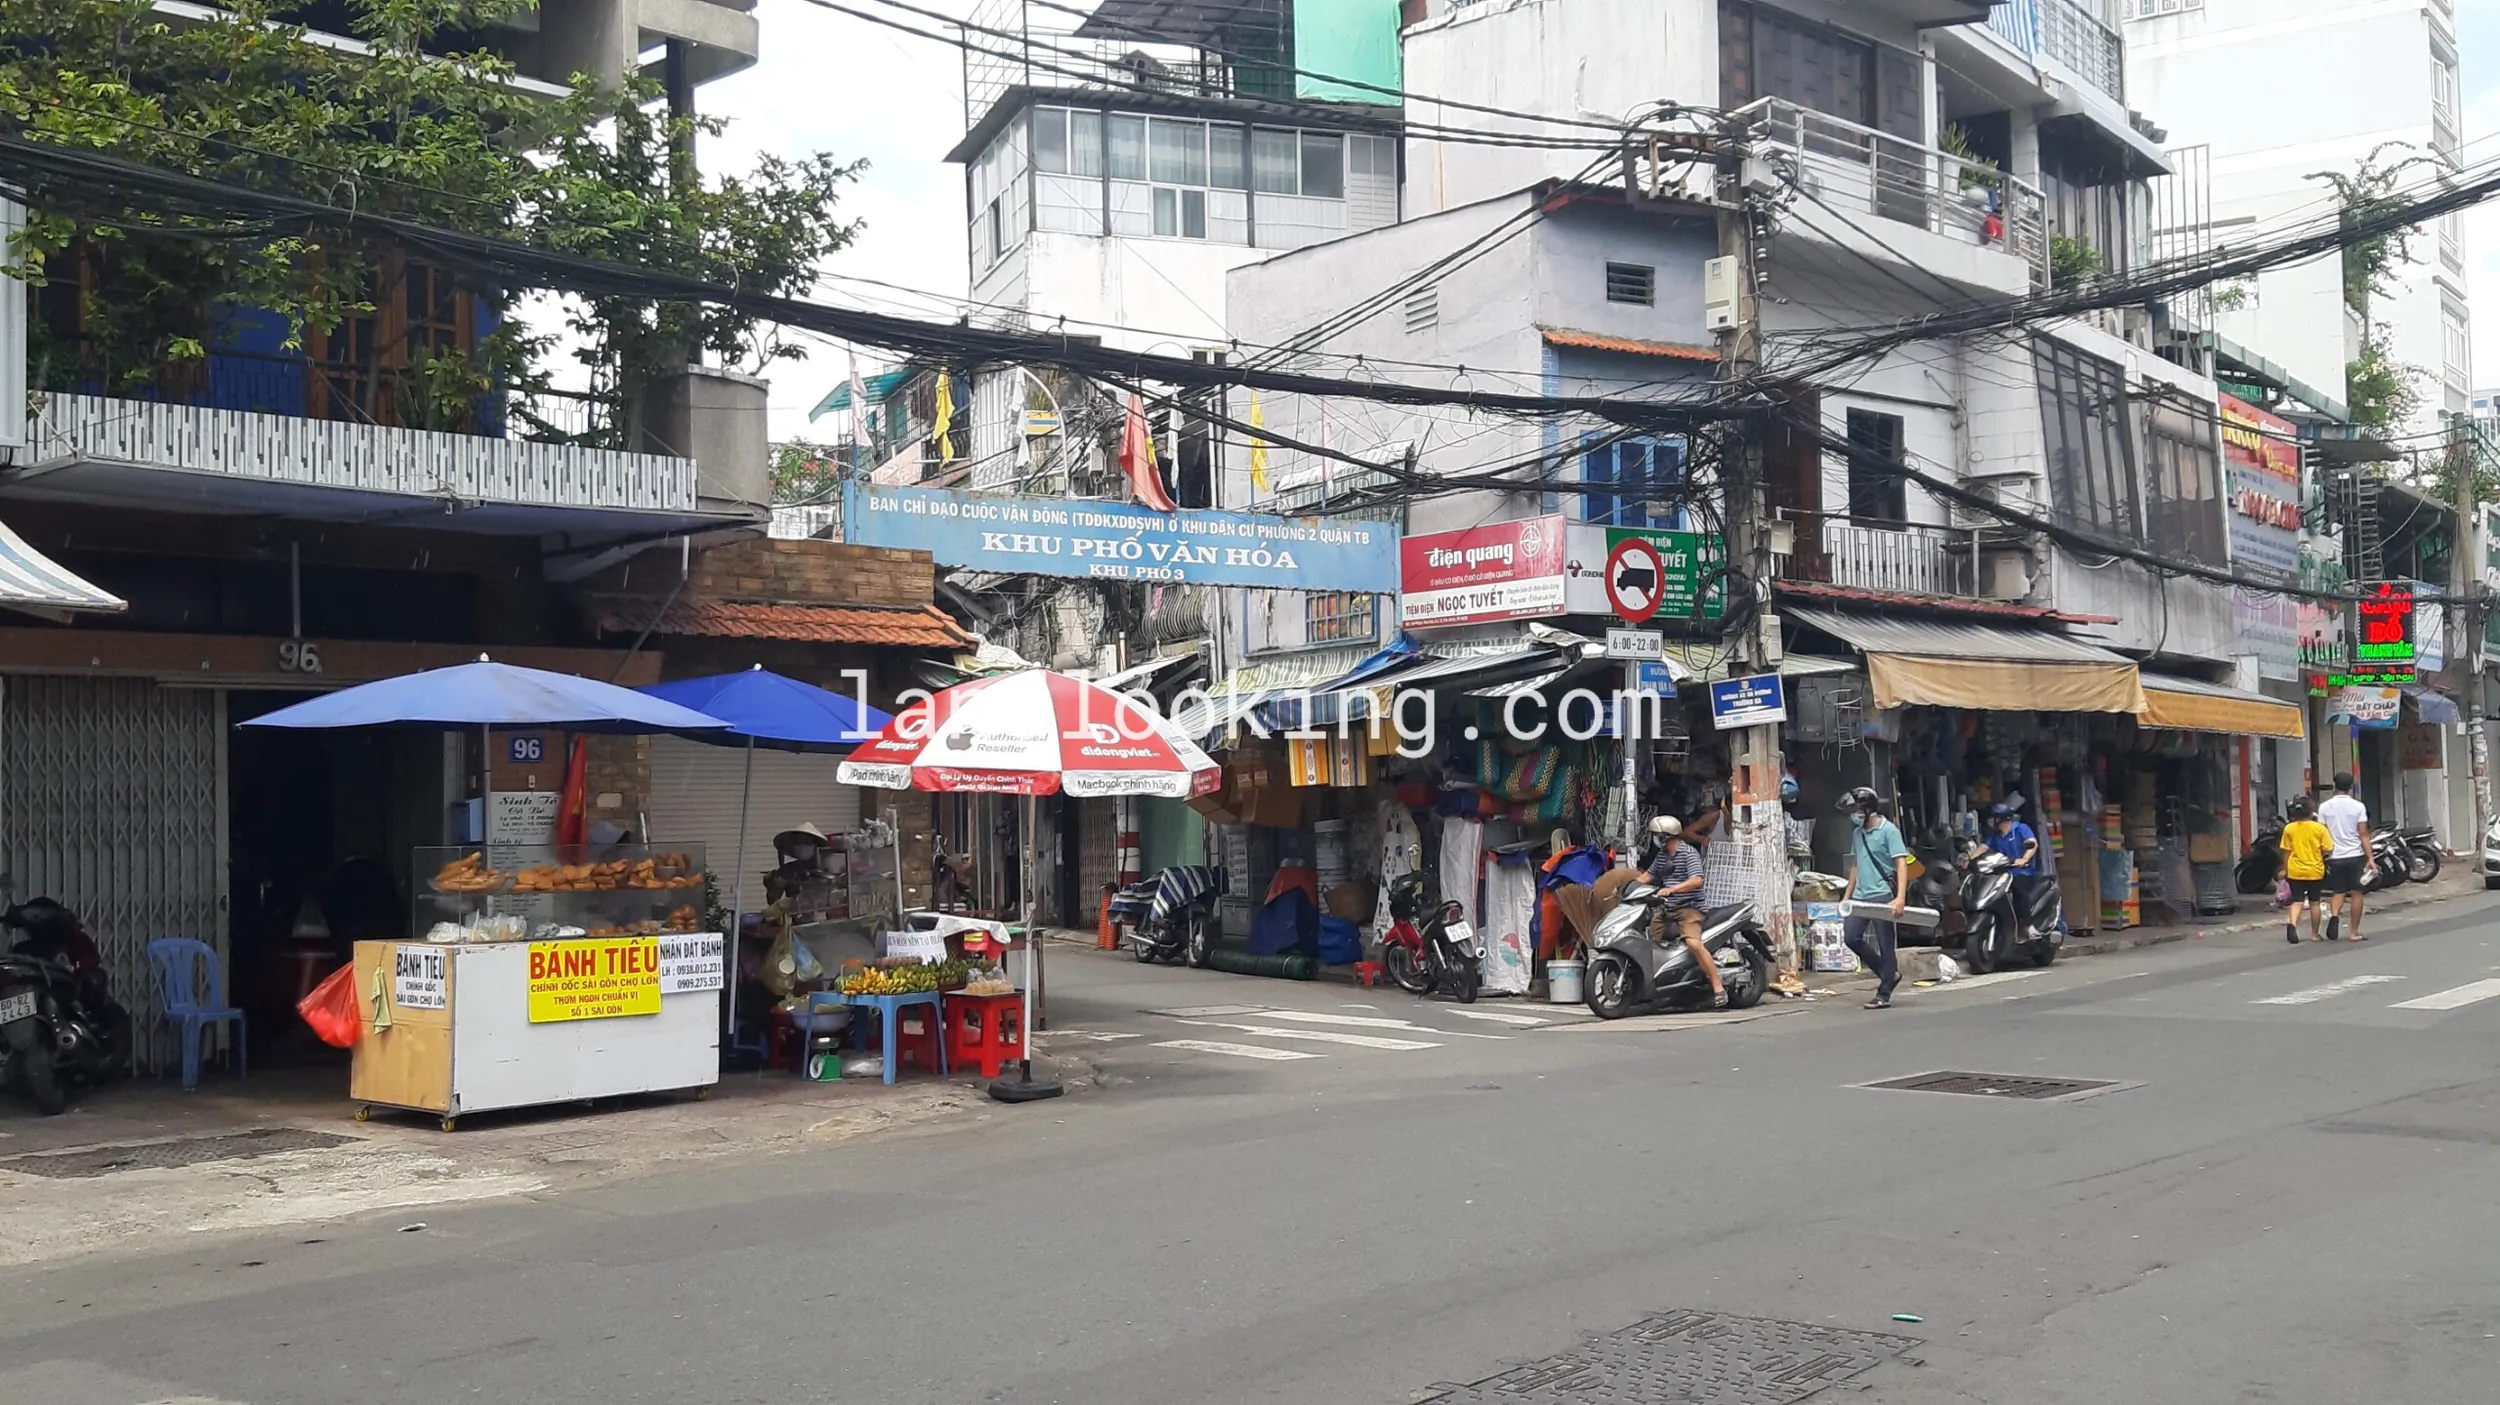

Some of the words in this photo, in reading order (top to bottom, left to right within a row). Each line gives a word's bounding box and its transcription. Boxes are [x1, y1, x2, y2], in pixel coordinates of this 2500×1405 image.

[870, 497, 899, 512] BAN
[903, 495, 926, 514] CHỈ
[931, 502, 958, 519] ĐẠO
[962, 502, 998, 520] CUỘC
[1002, 506, 1029, 523] VẬN
[1032, 506, 1068, 527] ĐỘNG
[1182, 520, 1206, 534] KHU
[1210, 520, 1235, 536] DÂN
[1239, 522, 1256, 537] CƯ
[1308, 530, 1317, 541] 2
[1320, 529, 1351, 546] QUẬN
[1354, 531, 1370, 545] TB
[980, 532, 1063, 555] KHU
[1071, 529, 1143, 560] PHỐ
[1147, 539, 1219, 565] VĂN
[1224, 542, 1298, 569] HÓA
[1424, 547, 1462, 568] điện
[1466, 543, 1514, 569] quang
[1089, 564, 1128, 577] KHU
[1136, 562, 1172, 579] PHỐ
[1174, 569, 1185, 580] 3
[1437, 594, 1467, 614] NGỌC
[1469, 585, 1504, 609] TUYẾT
[1612, 637, 1659, 652] 6:00-22:00
[278, 640, 319, 673] 96
[514, 738, 541, 759] 96
[977, 743, 1027, 754] Reseller
[1078, 778, 1122, 789] Macbook
[499, 796, 532, 805] Sinh
[701, 937, 722, 957] BÁNH
[397, 948, 421, 979] BÁNH
[424, 949, 446, 980] TIÊU
[530, 943, 596, 980] BÁNH
[605, 939, 658, 975] TIÊU
[662, 966, 671, 976] LH
[677, 962, 722, 976] 0938.012.231
[530, 981, 558, 993] CHÍNH
[561, 977, 580, 991] GỐC
[599, 976, 617, 988] GÒN
[620, 976, 638, 988] CHỢ
[677, 977, 722, 990] 0909.275.537
[579, 993, 600, 1004] NGON
[584, 1006, 589, 1016] 1
